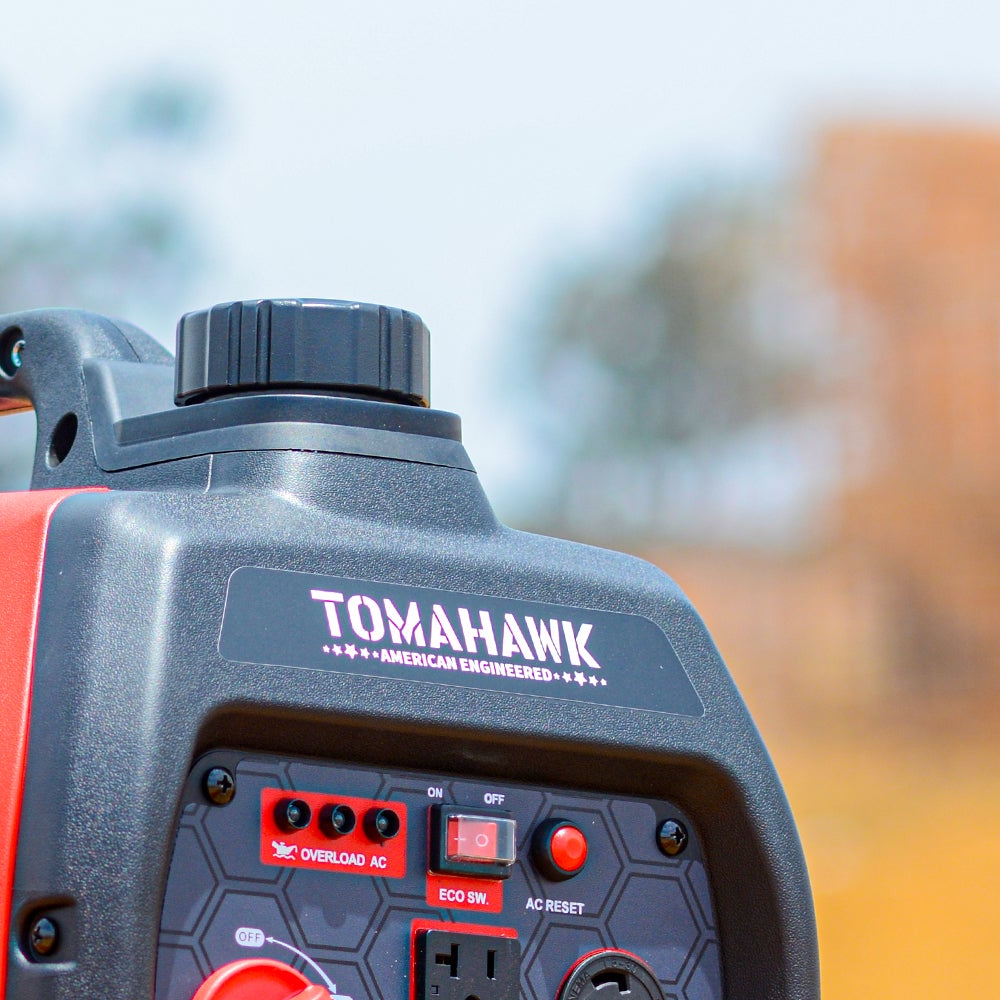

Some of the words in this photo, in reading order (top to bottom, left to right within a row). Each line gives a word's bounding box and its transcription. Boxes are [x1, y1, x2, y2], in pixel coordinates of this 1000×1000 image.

[310, 589, 601, 669] TOMAHAWK
[380, 648, 458, 670] AMERICAN
[460, 657, 553, 682] ENGINEERED
[427, 787, 443, 798] ON
[484, 793, 505, 805] OFF
[300, 848, 366, 867] OVERLOAD
[370, 856, 387, 869] AC
[439, 888, 465, 903] ECO
[467, 891, 489, 905] SW.
[525, 898, 544, 911] AC
[545, 900, 585, 915] RESET
[238, 931, 261, 943] OFF
